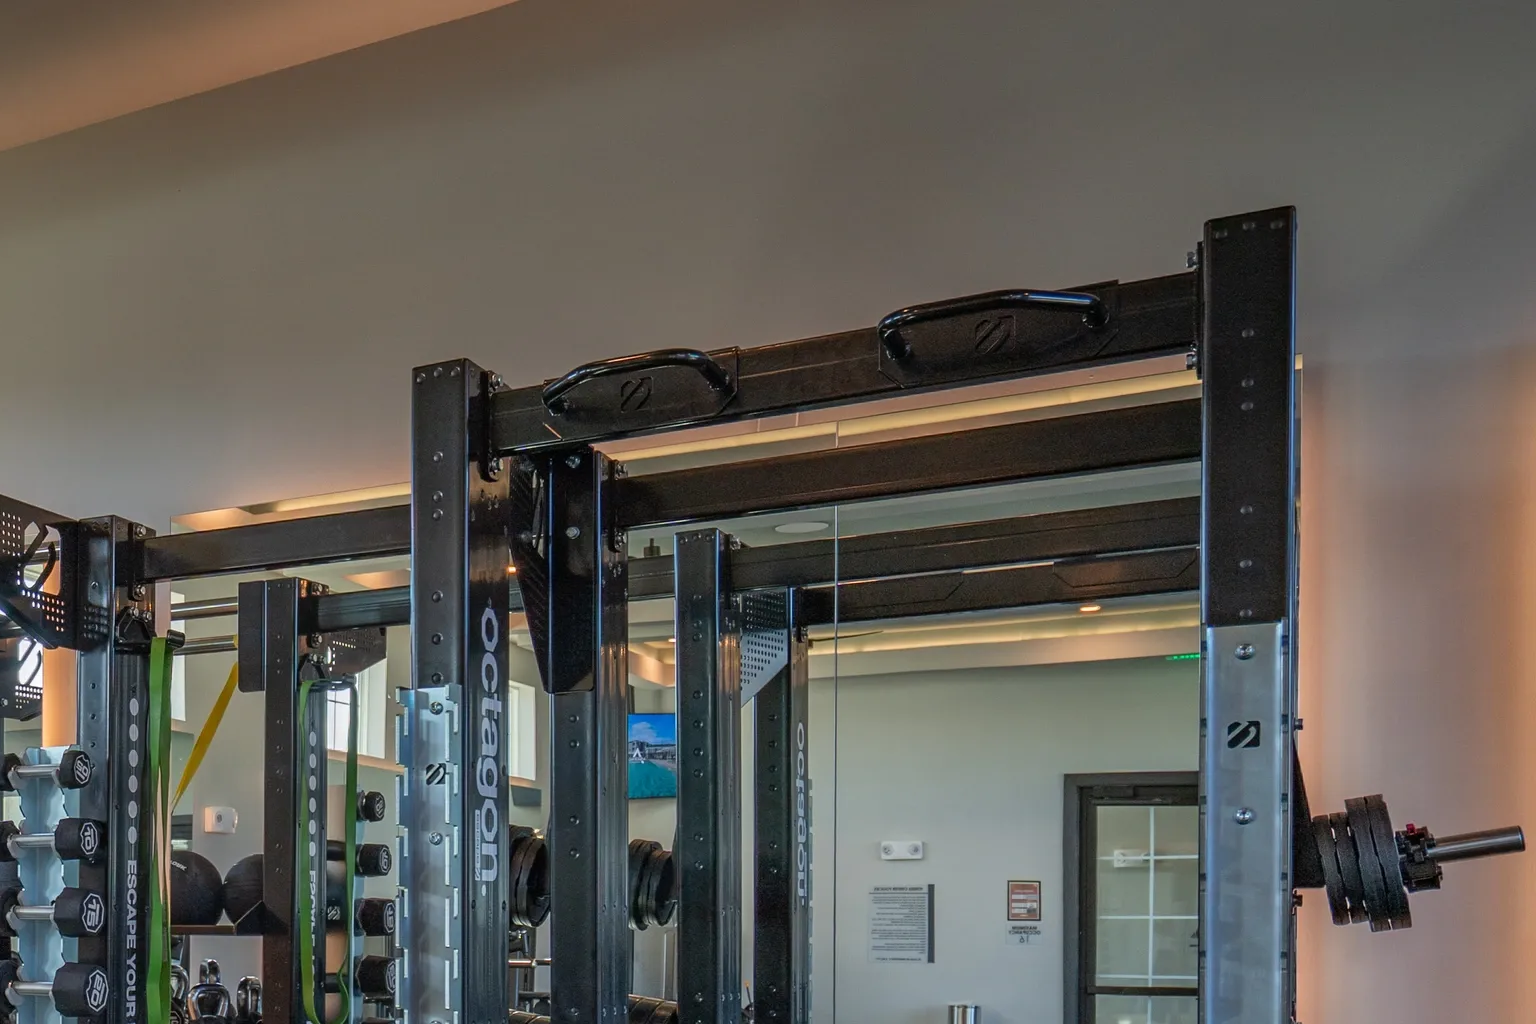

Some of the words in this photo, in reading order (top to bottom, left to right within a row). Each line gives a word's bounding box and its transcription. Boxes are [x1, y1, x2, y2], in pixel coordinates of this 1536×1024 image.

[476, 607, 502, 882] octagon
[83, 826, 93, 849] 10
[87, 898, 97, 922] 15
[126, 859, 138, 949] ESCAPE
[91, 977, 102, 1006] 20
[125, 952, 137, 1015] YOUR
